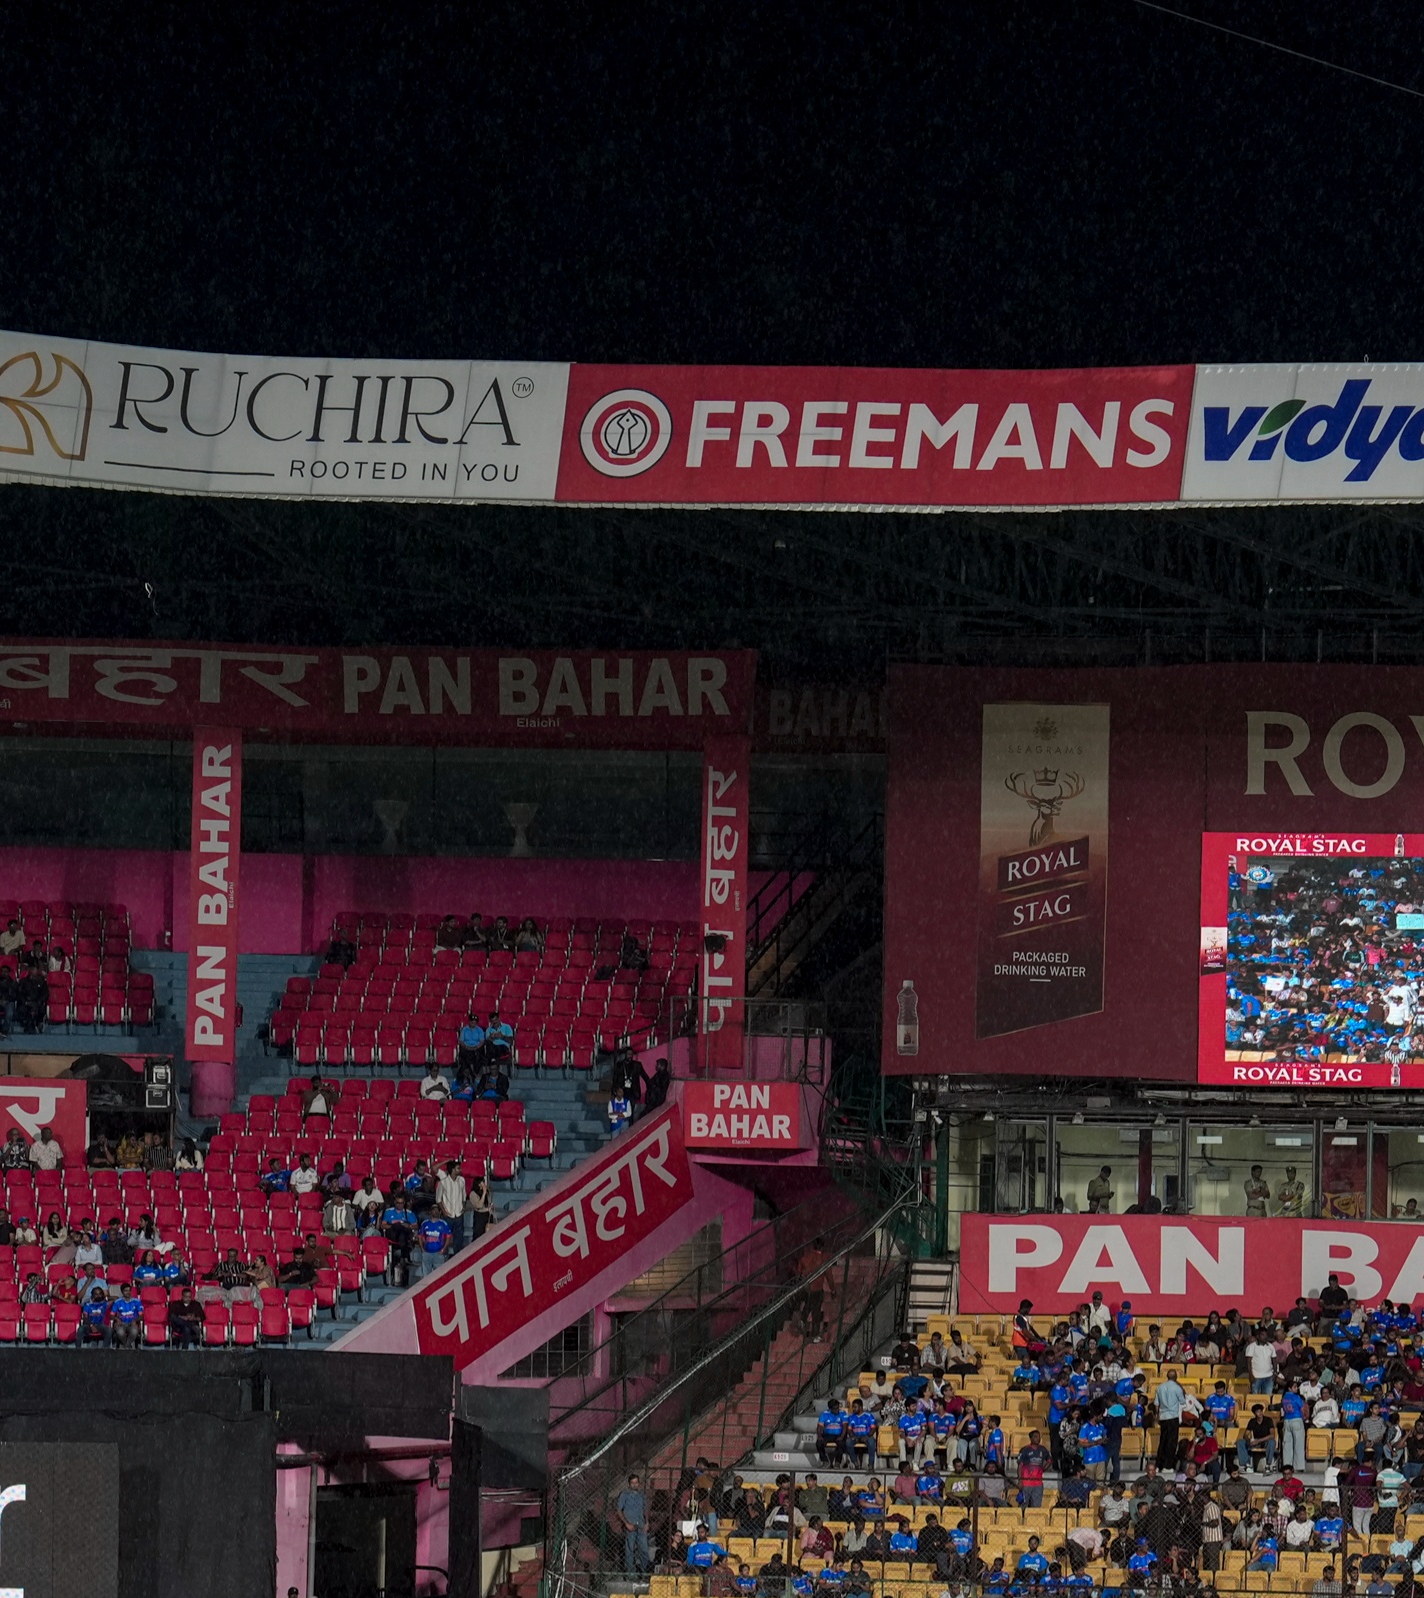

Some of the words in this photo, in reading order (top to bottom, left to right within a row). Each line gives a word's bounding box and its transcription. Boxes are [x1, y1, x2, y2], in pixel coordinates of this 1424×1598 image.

[109, 361, 520, 446] RUCHIRA
[685, 399, 1174, 470] FREEMANS
[290, 459, 407, 480] ROOTED
[421, 463, 447, 480] IN
[462, 463, 520, 482] YOU
[343, 655, 472, 714] PAN
[498, 657, 729, 716] BAHAR
[516, 717, 559, 728] Elaichi
[198, 744, 232, 925] BAHAR
[705, 766, 739, 906] बहार
[1236, 839, 1307, 852] ROYAL
[1312, 839, 1366, 853] STAG
[1008, 847, 1080, 881] ROYAL
[1013, 895, 1071, 926] STAG
[994, 965, 1046, 976] DRINKING
[1050, 966, 1086, 977] WATER
[1013, 952, 1069, 963] PACKAGED
[194, 946, 226, 1045] PAN
[1233, 1067, 1303, 1081] ROYAL
[1309, 1067, 1362, 1082] STAG
[714, 1084, 770, 1109] PAN
[691, 1113, 791, 1139] BAHAR
[426, 1225, 533, 1344] पान
[545, 1120, 677, 1259] बहार
[988, 1225, 1244, 1295] PAN
